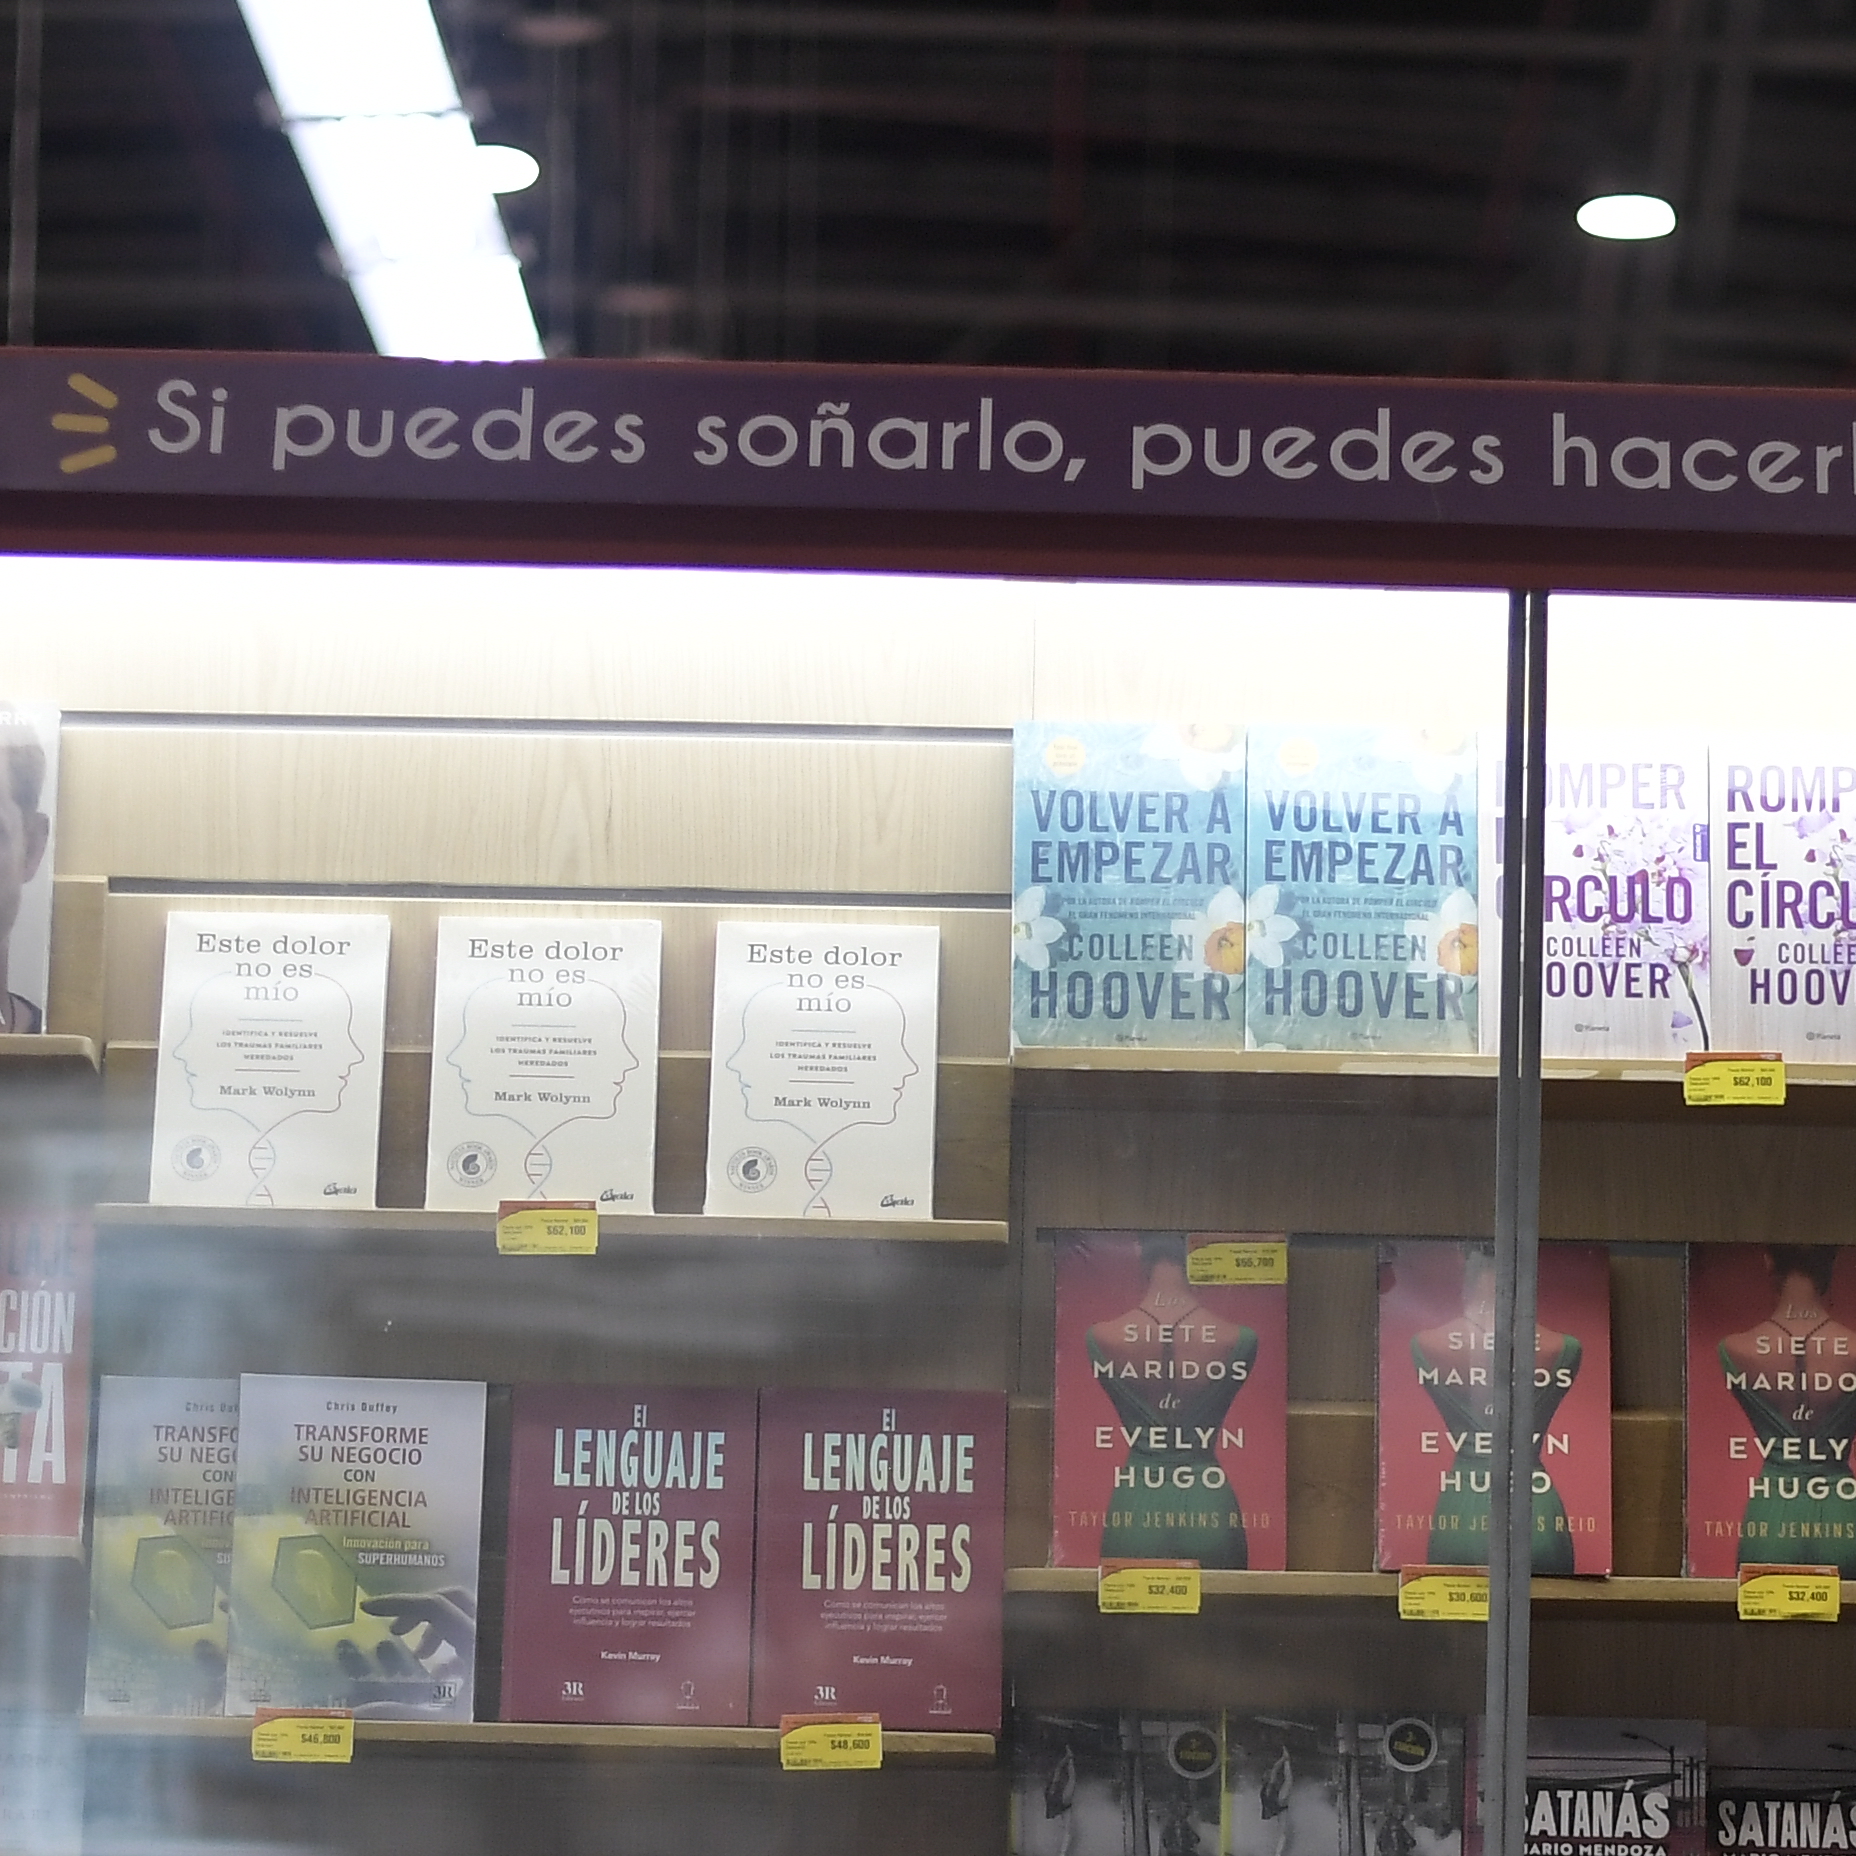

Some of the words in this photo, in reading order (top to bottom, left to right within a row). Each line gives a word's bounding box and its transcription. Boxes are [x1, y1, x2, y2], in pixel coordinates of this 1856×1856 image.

[147, 379, 229, 456] Si
[273, 389, 647, 473] puedes
[695, 401, 1085, 486] soñarlo,
[1131, 409, 1505, 491] puedes
[1031, 790, 1189, 833] VOLVER
[1206, 791, 1231, 834] A
[1727, 822, 1778, 870] EL
[1031, 841, 1231, 884] EMPEZAR
[1264, 842, 1465, 886] EMPEZAR
[196, 934, 263, 955] Este
[271, 934, 351, 957] dolor
[747, 944, 812, 965] Este
[824, 946, 902, 967] dolor
[1068, 934, 1193, 961] COLLEEN
[235, 960, 268, 979] no
[275, 961, 313, 979] es
[244, 979, 299, 1003] mío
[787, 973, 823, 988] no
[835, 973, 864, 989] es
[796, 992, 851, 1013] mío
[1031, 972, 1230, 1020] HOOVER
[1263, 972, 1464, 1019] HOOVER
[774, 1097, 811, 1107] Mark
[818, 1098, 871, 1110] Wolynn
[1124, 1324, 1216, 1343] SIETE
[1094, 1360, 1248, 1381] MARIDOS
[326, 1401, 355, 1413] Chris
[361, 1401, 397, 1415] Duffey
[1159, 1394, 1181, 1409] de
[633, 1405, 647, 1427] El
[294, 1424, 428, 1444] TRANSFORME
[1096, 1426, 1244, 1449] EVELYN
[298, 1446, 324, 1463] SU
[331, 1447, 422, 1465] NEGOCIO
[553, 1428, 725, 1490] LENGUAJE
[803, 1432, 975, 1493] LENGUAJE
[344, 1469, 375, 1483] CON
[1114, 1466, 1226, 1489] HUGO
[290, 1487, 427, 1508] INTELIGENCIA
[612, 1492, 631, 1515] DE
[634, 1494, 660, 1516] LOS
[305, 1510, 411, 1528] ARTIFICIAL
[1069, 1511, 1133, 1528] TAYLOR
[1143, 1512, 1219, 1528] JENKINS
[1229, 1513, 1271, 1529] REID
[405, 1539, 429, 1552] para
[551, 1501, 720, 1588] LÍDERES
[802, 1505, 971, 1592] LÍDERES
[358, 1553, 445, 1566] SUPERHUMANOS
[601, 1651, 626, 1661] Kevin
[562, 1681, 584, 1696] 3R
